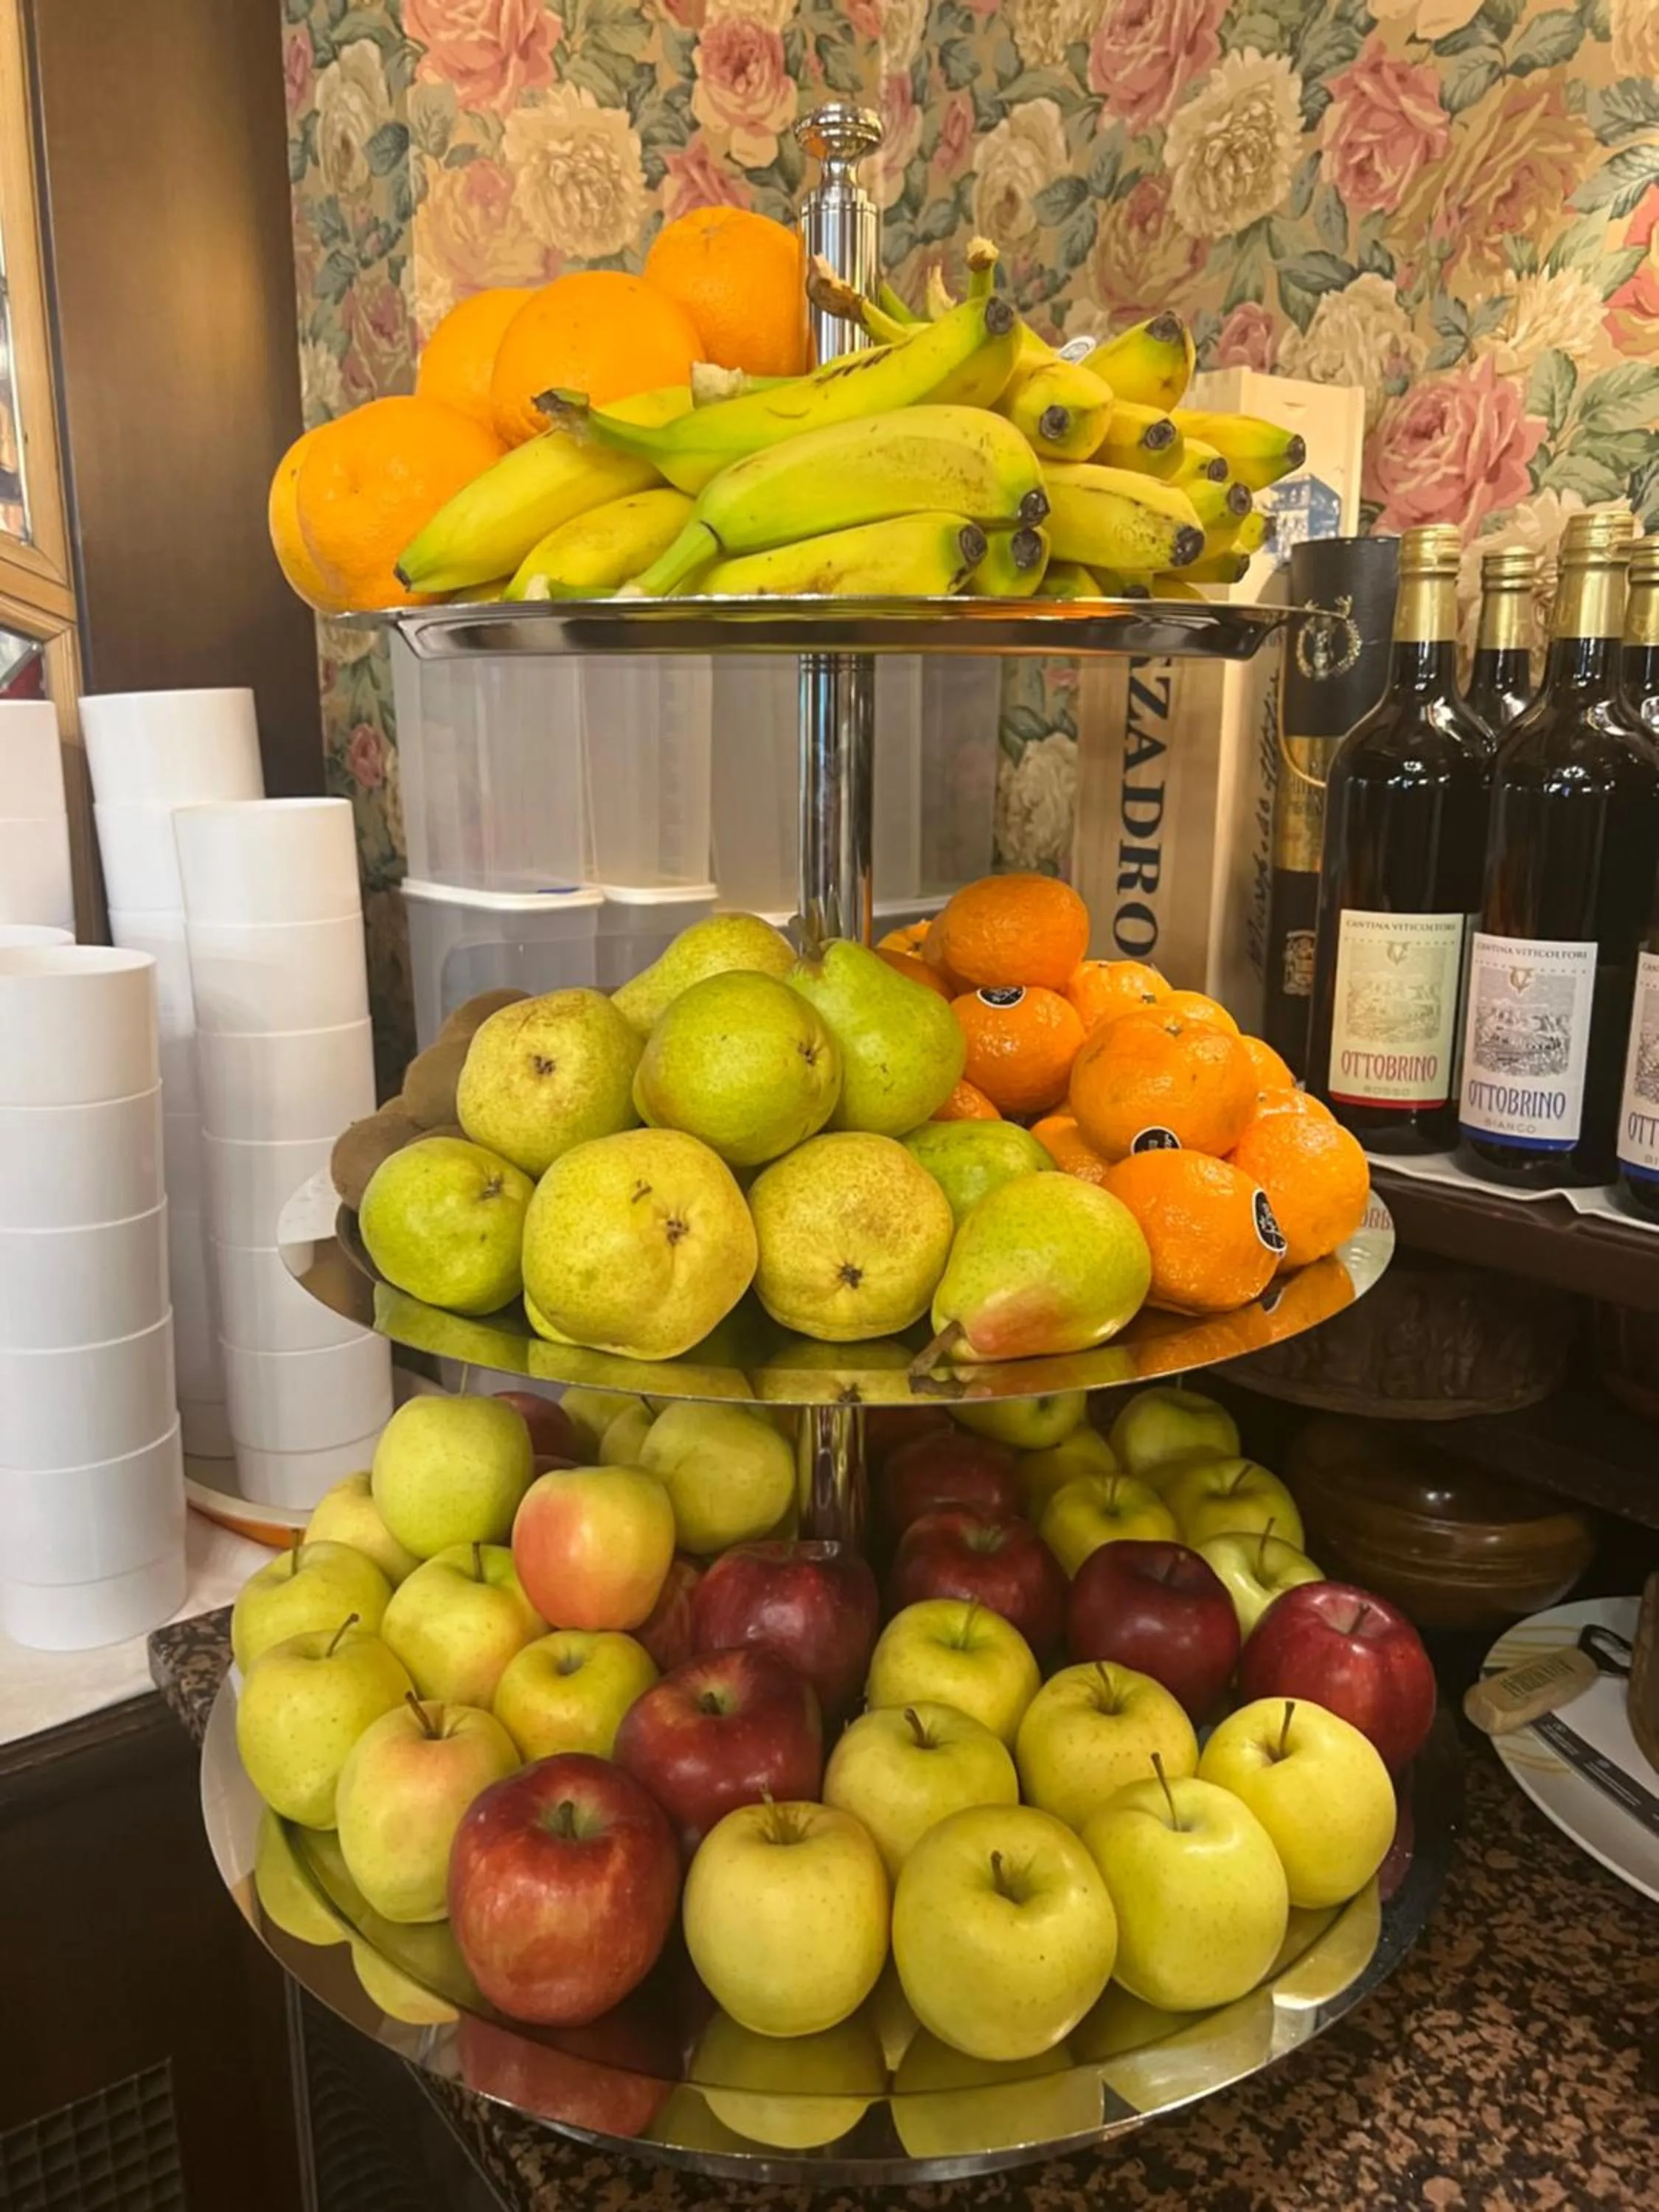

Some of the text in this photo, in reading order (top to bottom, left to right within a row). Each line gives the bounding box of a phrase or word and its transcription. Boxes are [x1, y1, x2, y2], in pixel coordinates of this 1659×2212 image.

[1346, 920, 1389, 931] CANTINA
[1341, 1049, 1439, 1082] OTTOBRINO
[1363, 1085, 1411, 1096] ROSSO
[1469, 1079, 1566, 1120] OTTOBRINO
[1484, 1118, 1537, 1134] BIANCO
